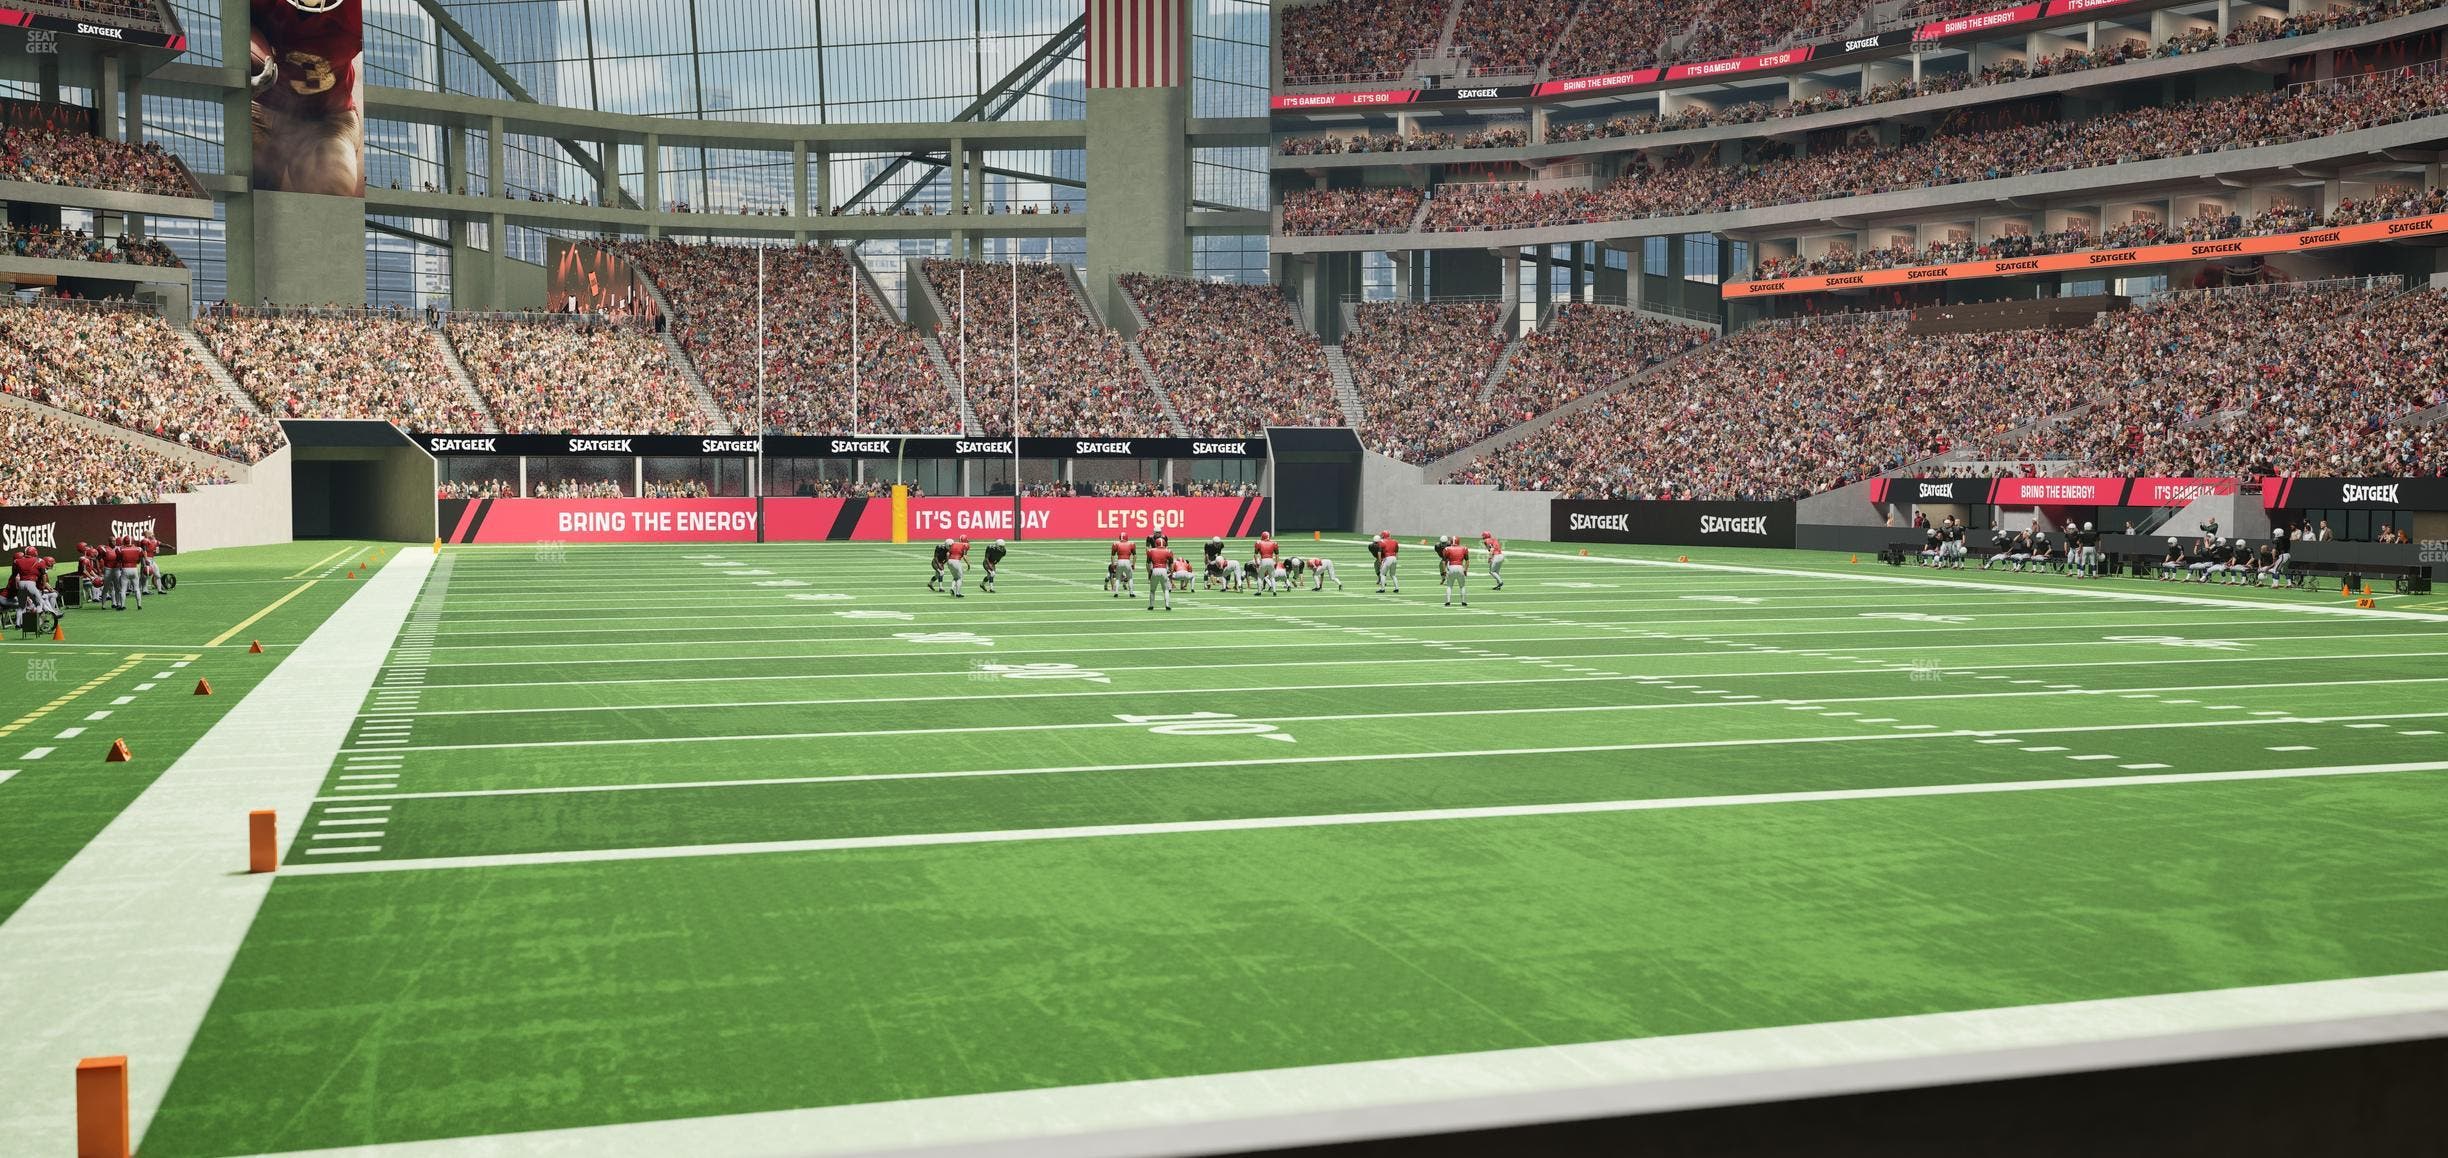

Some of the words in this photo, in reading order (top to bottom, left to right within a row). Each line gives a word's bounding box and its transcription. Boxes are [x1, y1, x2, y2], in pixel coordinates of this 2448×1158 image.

[1945, 22, 1968, 33] BRING
[1969, 19, 1983, 29] THE
[1983, 12, 2015, 26] ENERGY!
[77, 23, 123, 40] SEATGEEK
[1845, 36, 1880, 52] SEATGEEK
[286, 50, 337, 95] 3
[1563, 82, 1586, 91] BRING
[1587, 79, 1601, 88] THE
[1602, 75, 1634, 86] ENERGY!
[1353, 94, 1374, 103] LET'S
[1457, 88, 1498, 99] SEATGEEK
[2388, 219, 2433, 234] SEATGEEK
[2300, 231, 2340, 246] SEATGEEK
[2191, 242, 2242, 256] SEATGEEK
[2090, 251, 2137, 264] SEATGEEK
[1995, 259, 2039, 272] SEATGEEK
[1826, 275, 1864, 287] SEATGEEK
[1907, 268, 1948, 279] SEATGEEK
[1749, 282, 1785, 293] SEATGEEK
[430, 437, 497, 453] SEATGEEK
[569, 438, 633, 453] SEATGEEK
[702, 439, 763, 453] SEATGEEK
[831, 440, 891, 454] SEATGEEK
[955, 440, 1013, 454] SEATGEEK
[1076, 441, 1132, 455] SEATGEEK
[1192, 442, 1247, 455] SEATGEEK
[1919, 482, 1953, 499] SEATGEEK
[2020, 485, 2045, 499] BRING
[2046, 485, 2061, 499] THE
[2061, 485, 2095, 499] ENERGY!
[2154, 485, 2171, 500] IT'S
[2342, 483, 2399, 504] SEATGEEK
[559, 511, 626, 532] BRING
[632, 511, 672, 531] THE
[915, 510, 952, 530] IT'S
[1097, 509, 1149, 529] LET'S
[1152, 509, 1185, 528] GO!
[1570, 512, 1629, 532] SEATGEEK
[1700, 515, 1767, 536] SEATGEEK
[2, 521, 57, 552] SEATGEEK
[1112, 711, 1280, 735] 10
